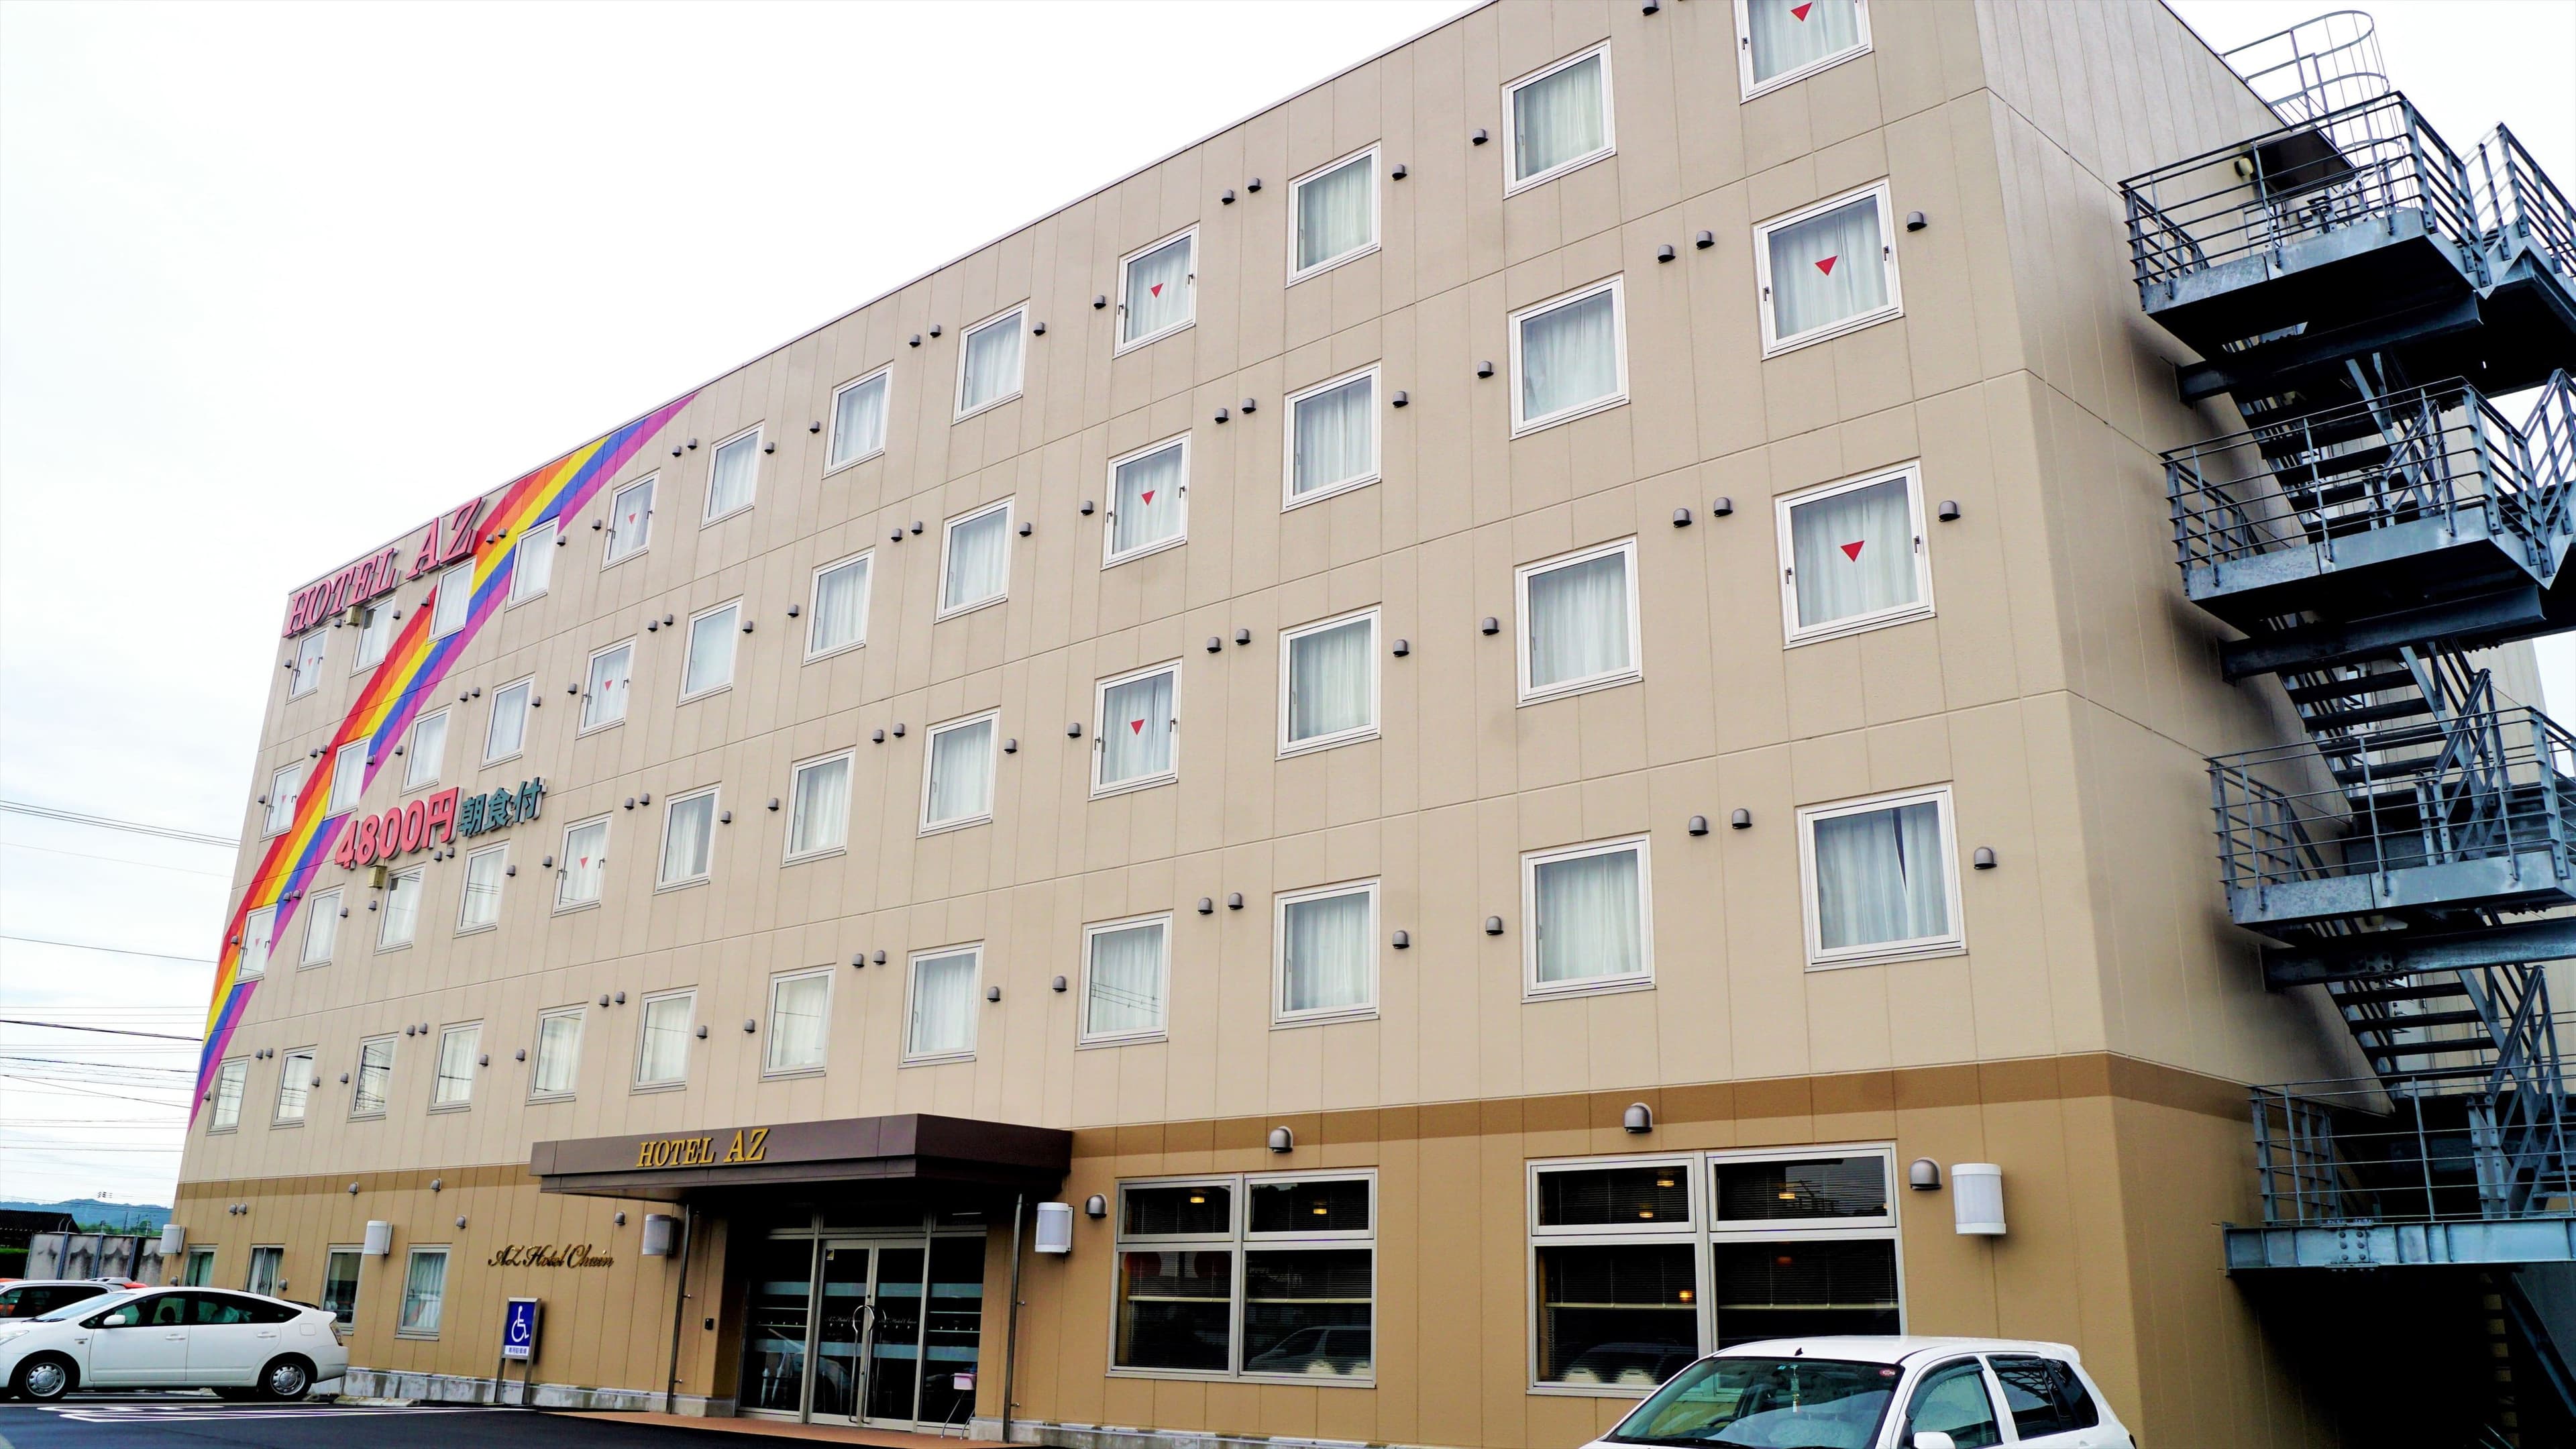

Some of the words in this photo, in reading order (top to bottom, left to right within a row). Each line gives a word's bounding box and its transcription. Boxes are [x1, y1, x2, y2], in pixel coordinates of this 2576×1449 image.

[282, 548, 400, 638] HOTEL
[405, 496, 486, 581] AZ
[334, 786, 463, 869] 4800円
[458, 777, 547, 838] 朝食付
[636, 1137, 716, 1168] HOTEL
[723, 1128, 770, 1163] AZ
[488, 1244, 525, 1267] AZ
[523, 1244, 569, 1267] Hotel
[567, 1243, 614, 1269] Chain
